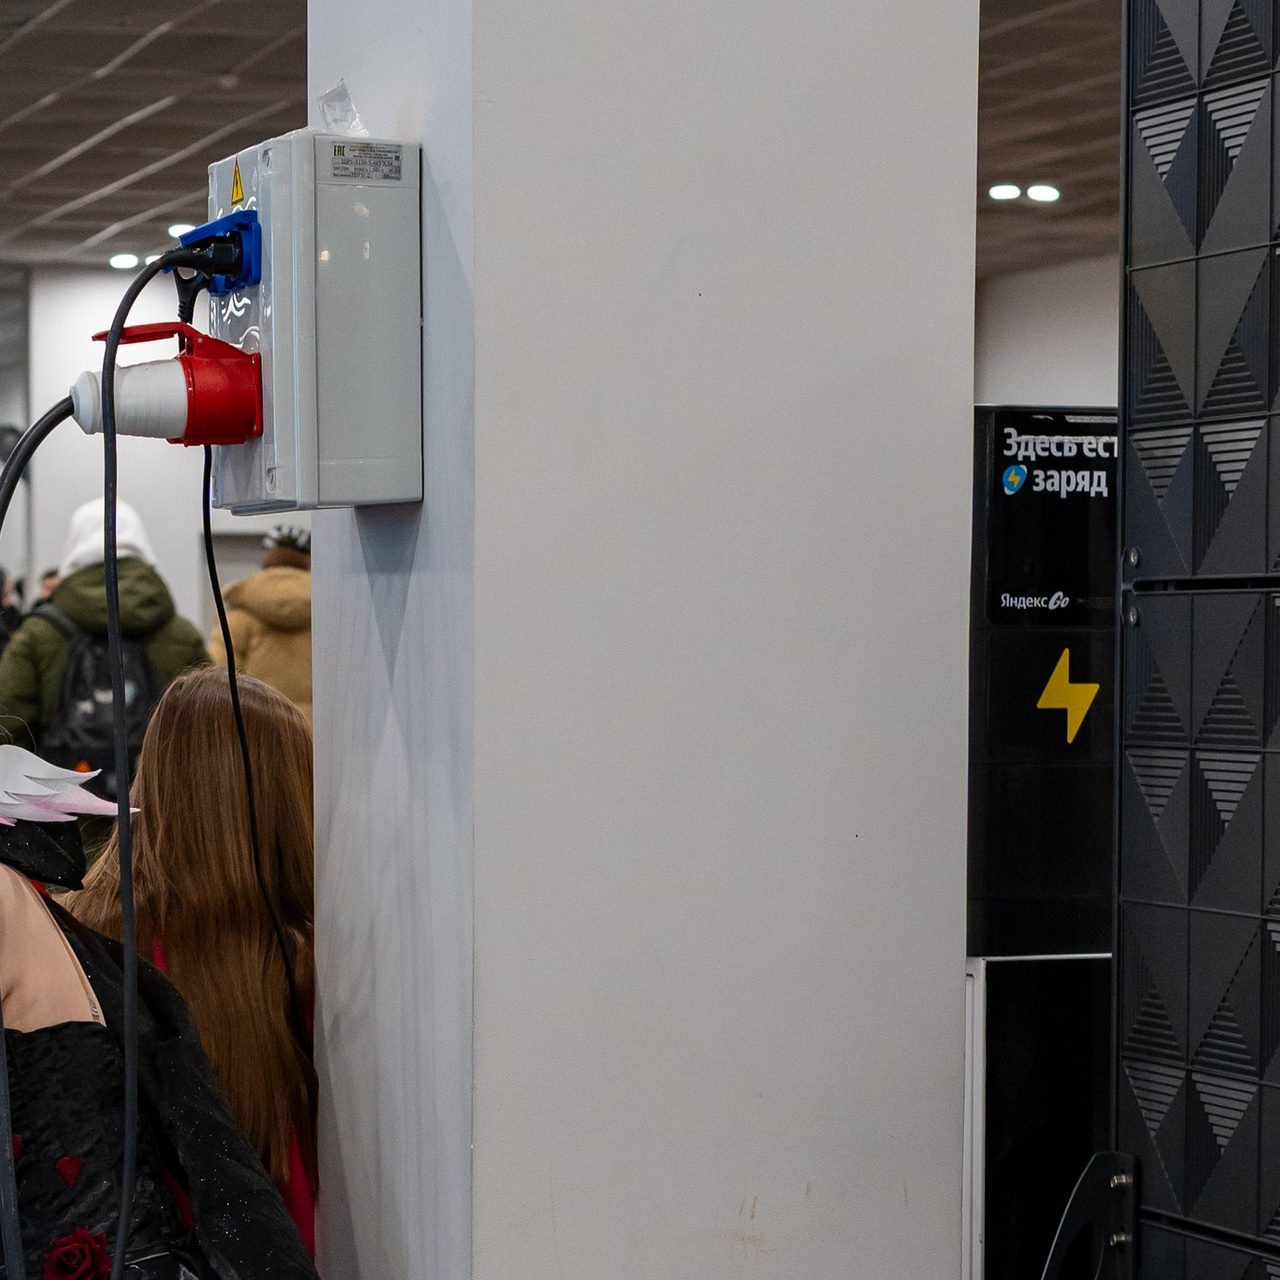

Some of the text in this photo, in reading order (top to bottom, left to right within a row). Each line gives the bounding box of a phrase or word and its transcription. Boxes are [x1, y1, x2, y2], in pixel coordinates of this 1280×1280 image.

[1003, 427, 1078, 461] Здесь
[1032, 469, 1108, 498] заряд
[1001, 593, 1048, 609] Яндекс
[1048, 591, 1070, 610] Go
